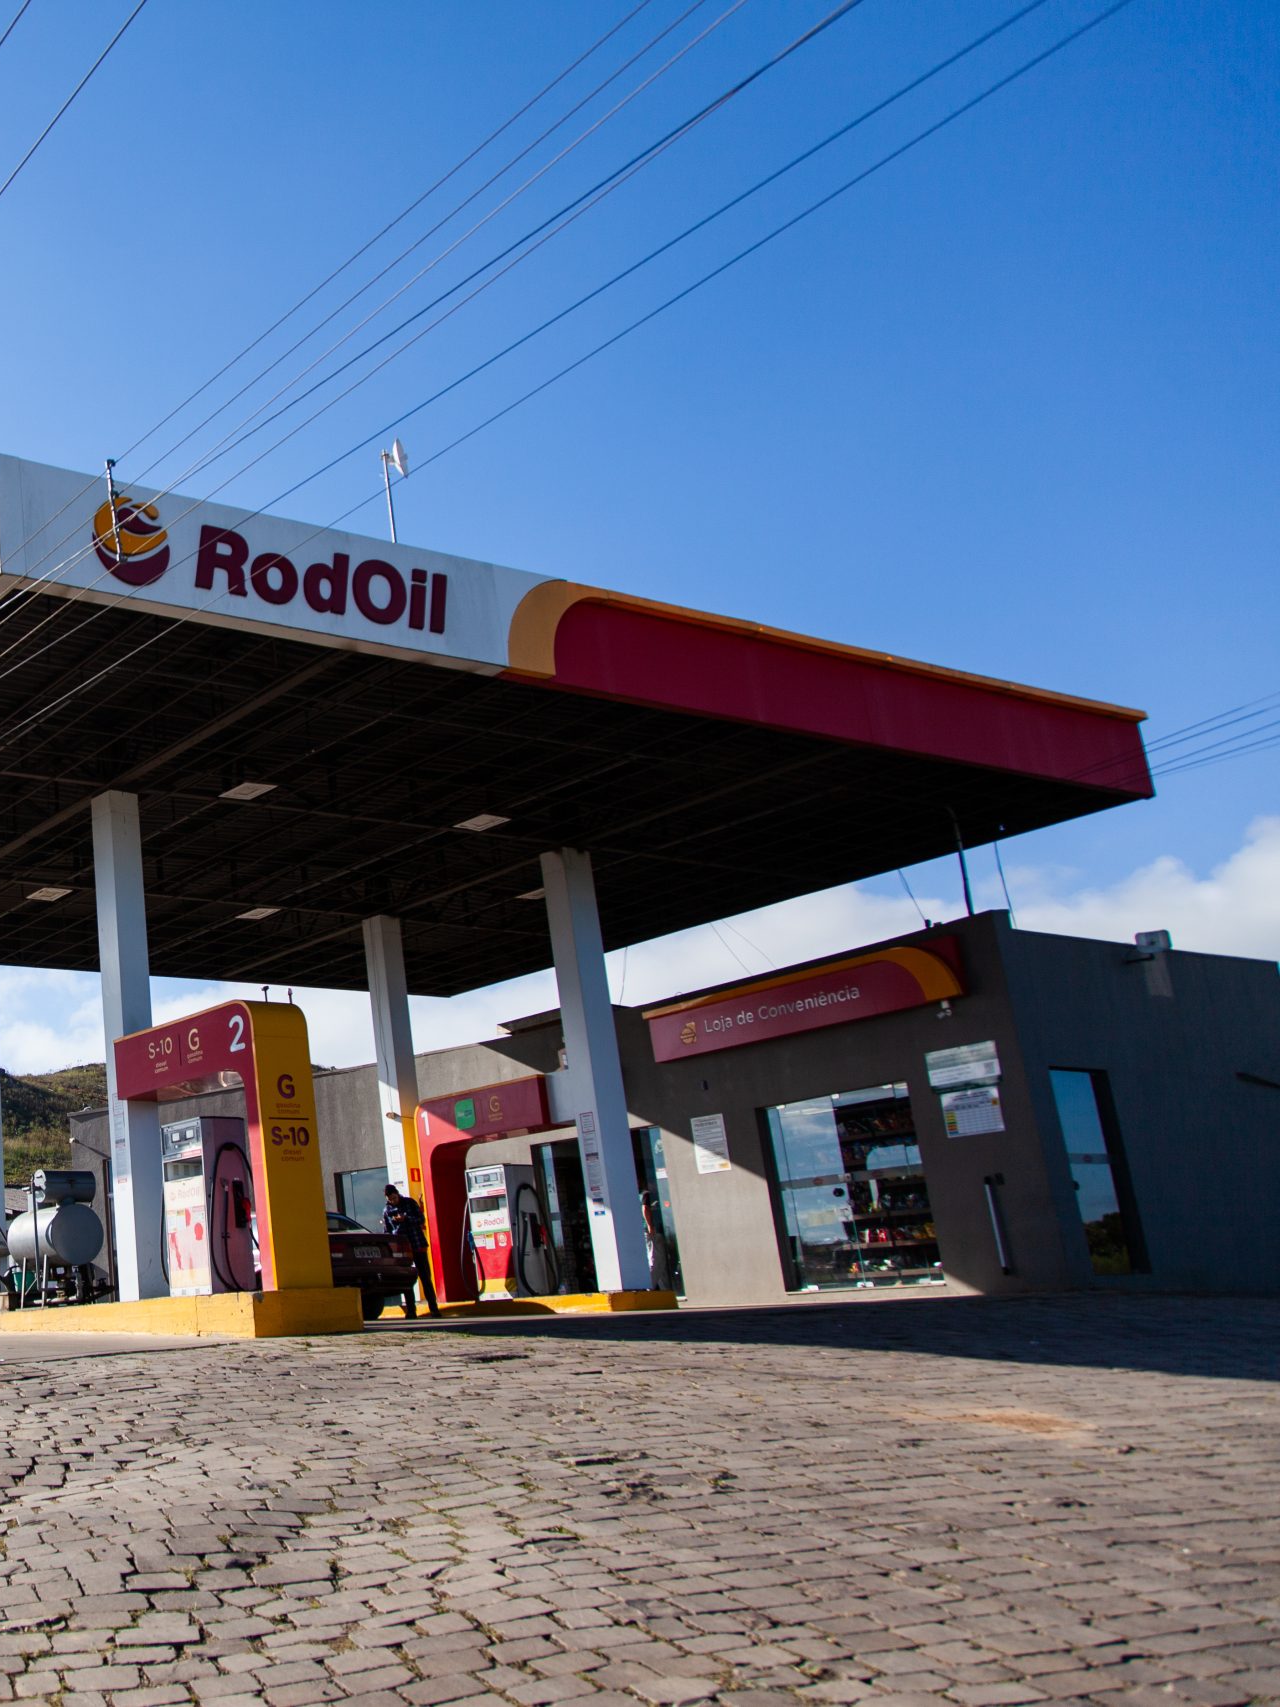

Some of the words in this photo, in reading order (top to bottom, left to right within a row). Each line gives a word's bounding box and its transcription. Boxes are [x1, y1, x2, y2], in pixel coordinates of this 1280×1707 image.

[194, 524, 448, 634] RodOil
[704, 1016, 732, 1033] Loja
[737, 1011, 754, 1025] de
[758, 985, 860, 1020] Conveniência
[188, 1028, 200, 1051] G
[229, 1014, 246, 1053] 2
[148, 1037, 173, 1059] S-10
[277, 1074, 296, 1099] G
[489, 1096, 500, 1112] G
[421, 1110, 431, 1136] 1
[271, 1126, 310, 1146] S-10
